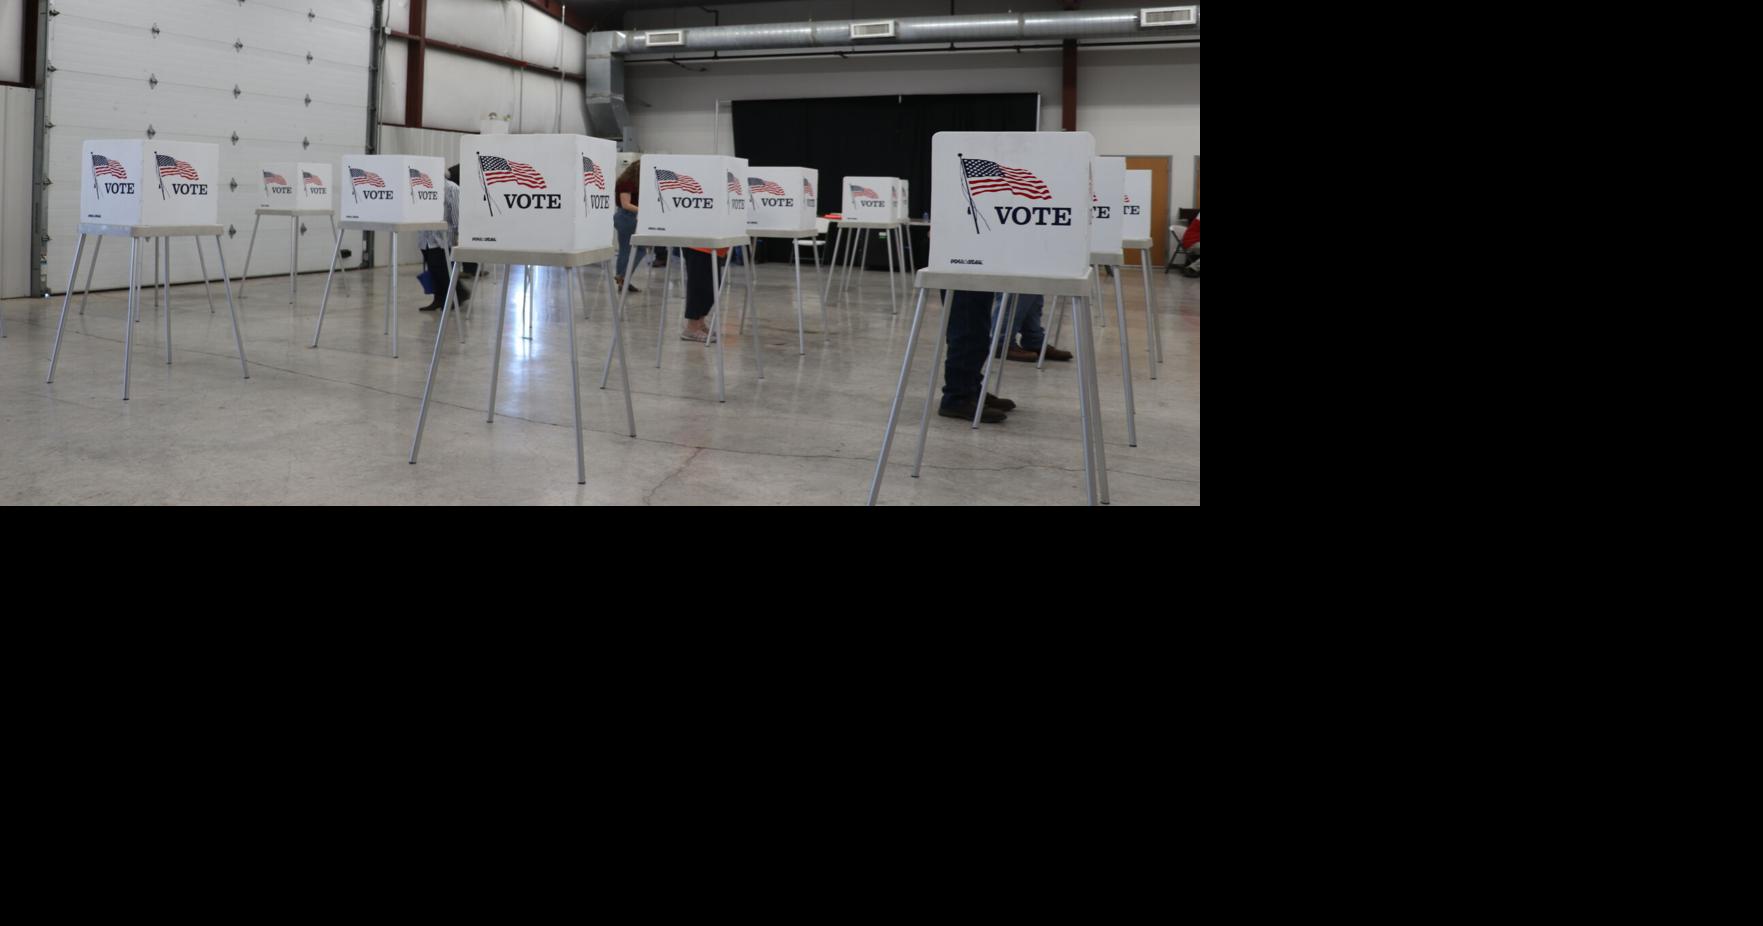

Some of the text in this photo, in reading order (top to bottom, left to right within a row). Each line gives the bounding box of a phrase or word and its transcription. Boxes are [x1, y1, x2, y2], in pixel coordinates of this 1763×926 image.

[104, 183, 135, 194] VOTE
[172, 184, 208, 195] VOTE
[363, 190, 393, 200] VOTE
[418, 191, 438, 200] VOTE
[504, 194, 562, 210] VOTE
[590, 195, 610, 210] VOTE
[672, 197, 714, 209] VOTE
[761, 198, 794, 207] VOTE
[860, 200, 885, 208] VOTE
[994, 206, 1072, 226] VOTE
